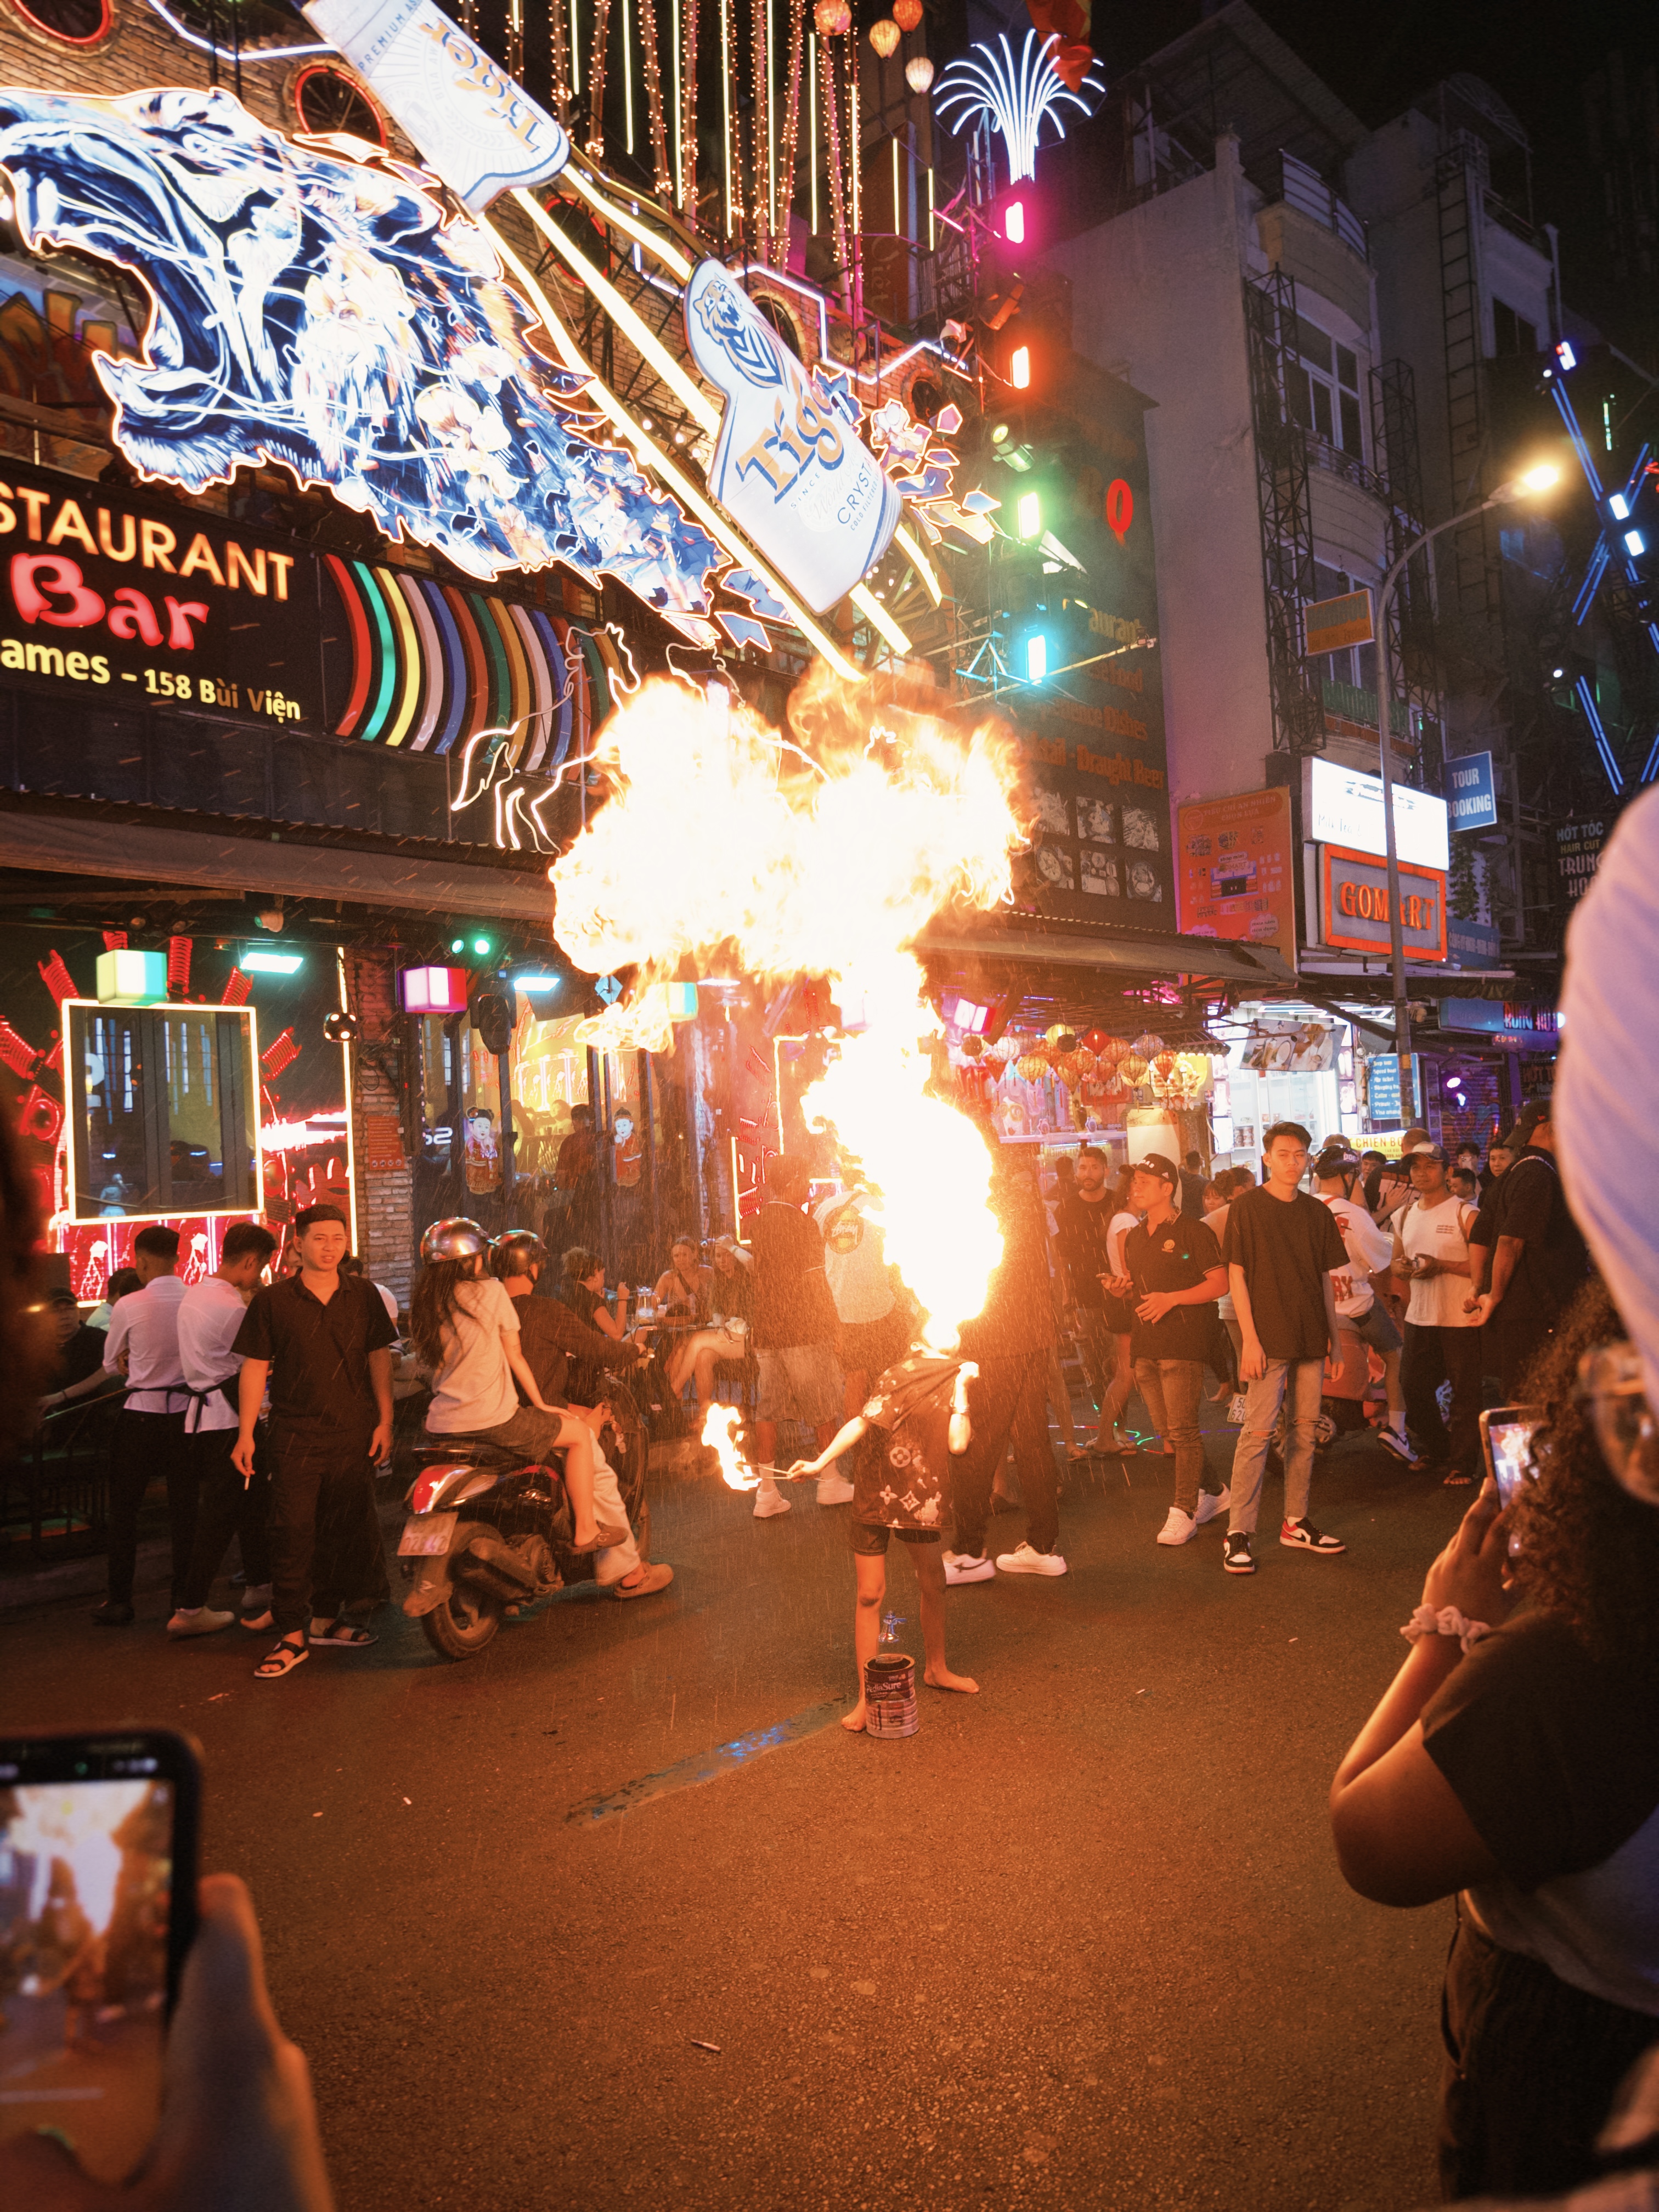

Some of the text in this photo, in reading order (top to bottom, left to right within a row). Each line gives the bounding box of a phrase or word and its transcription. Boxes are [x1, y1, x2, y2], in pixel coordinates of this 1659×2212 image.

[357, 13, 406, 72] PREMIUM
[790, 472, 821, 510] SINCE
[850, 512, 864, 531] COLD
[0, 482, 294, 602] STAURANT
[10, 552, 210, 650] Bar
[1, 639, 111, 684] ames
[144, 669, 192, 699] 158
[200, 678, 238, 709] Bùi
[247, 689, 301, 723] Viện
[1452, 768, 1480, 789] TOUR
[1448, 794, 1492, 819] BOOKING
[1560, 839, 1601, 854] HAIR CUT
[866, 1681, 901, 1694] PediaSure
